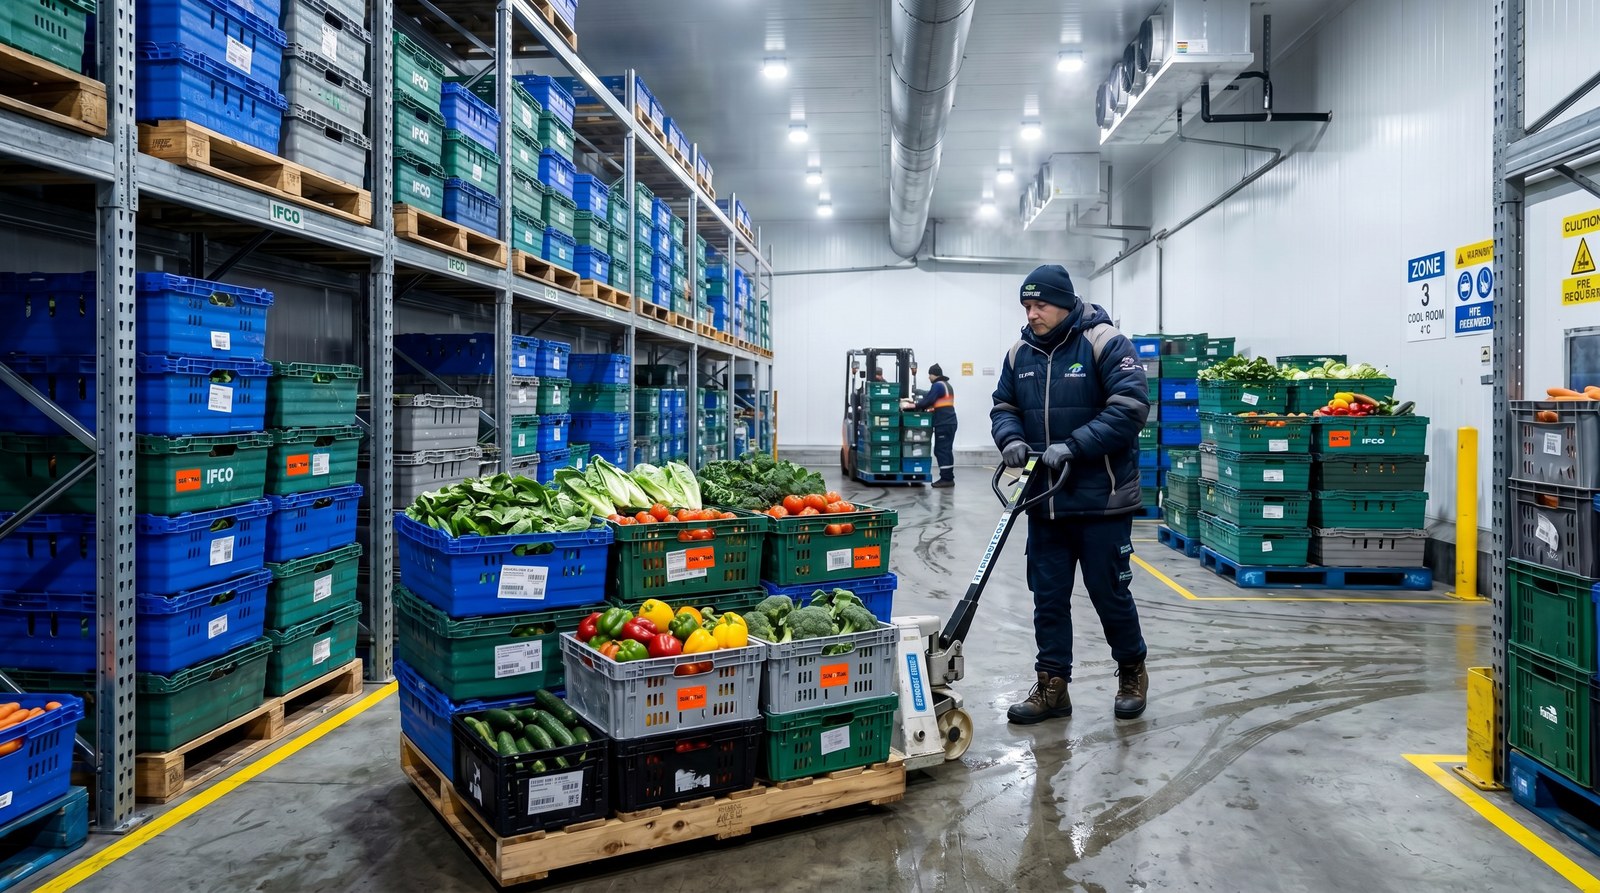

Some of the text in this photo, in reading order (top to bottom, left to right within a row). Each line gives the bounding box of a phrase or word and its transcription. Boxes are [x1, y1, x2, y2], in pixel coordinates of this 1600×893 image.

[412, 71, 429, 92] IFCO
[412, 125, 429, 145] IFCO
[412, 180, 431, 199] IFCO
[273, 204, 300, 224] IFCO
[449, 258, 465, 272] IFCO
[1411, 256, 1441, 278] ZONE
[1576, 278, 1591, 289] PRE
[1421, 283, 1430, 307] 3
[1408, 309, 1445, 323] COOL ROOM
[206, 467, 234, 484] IFCO
